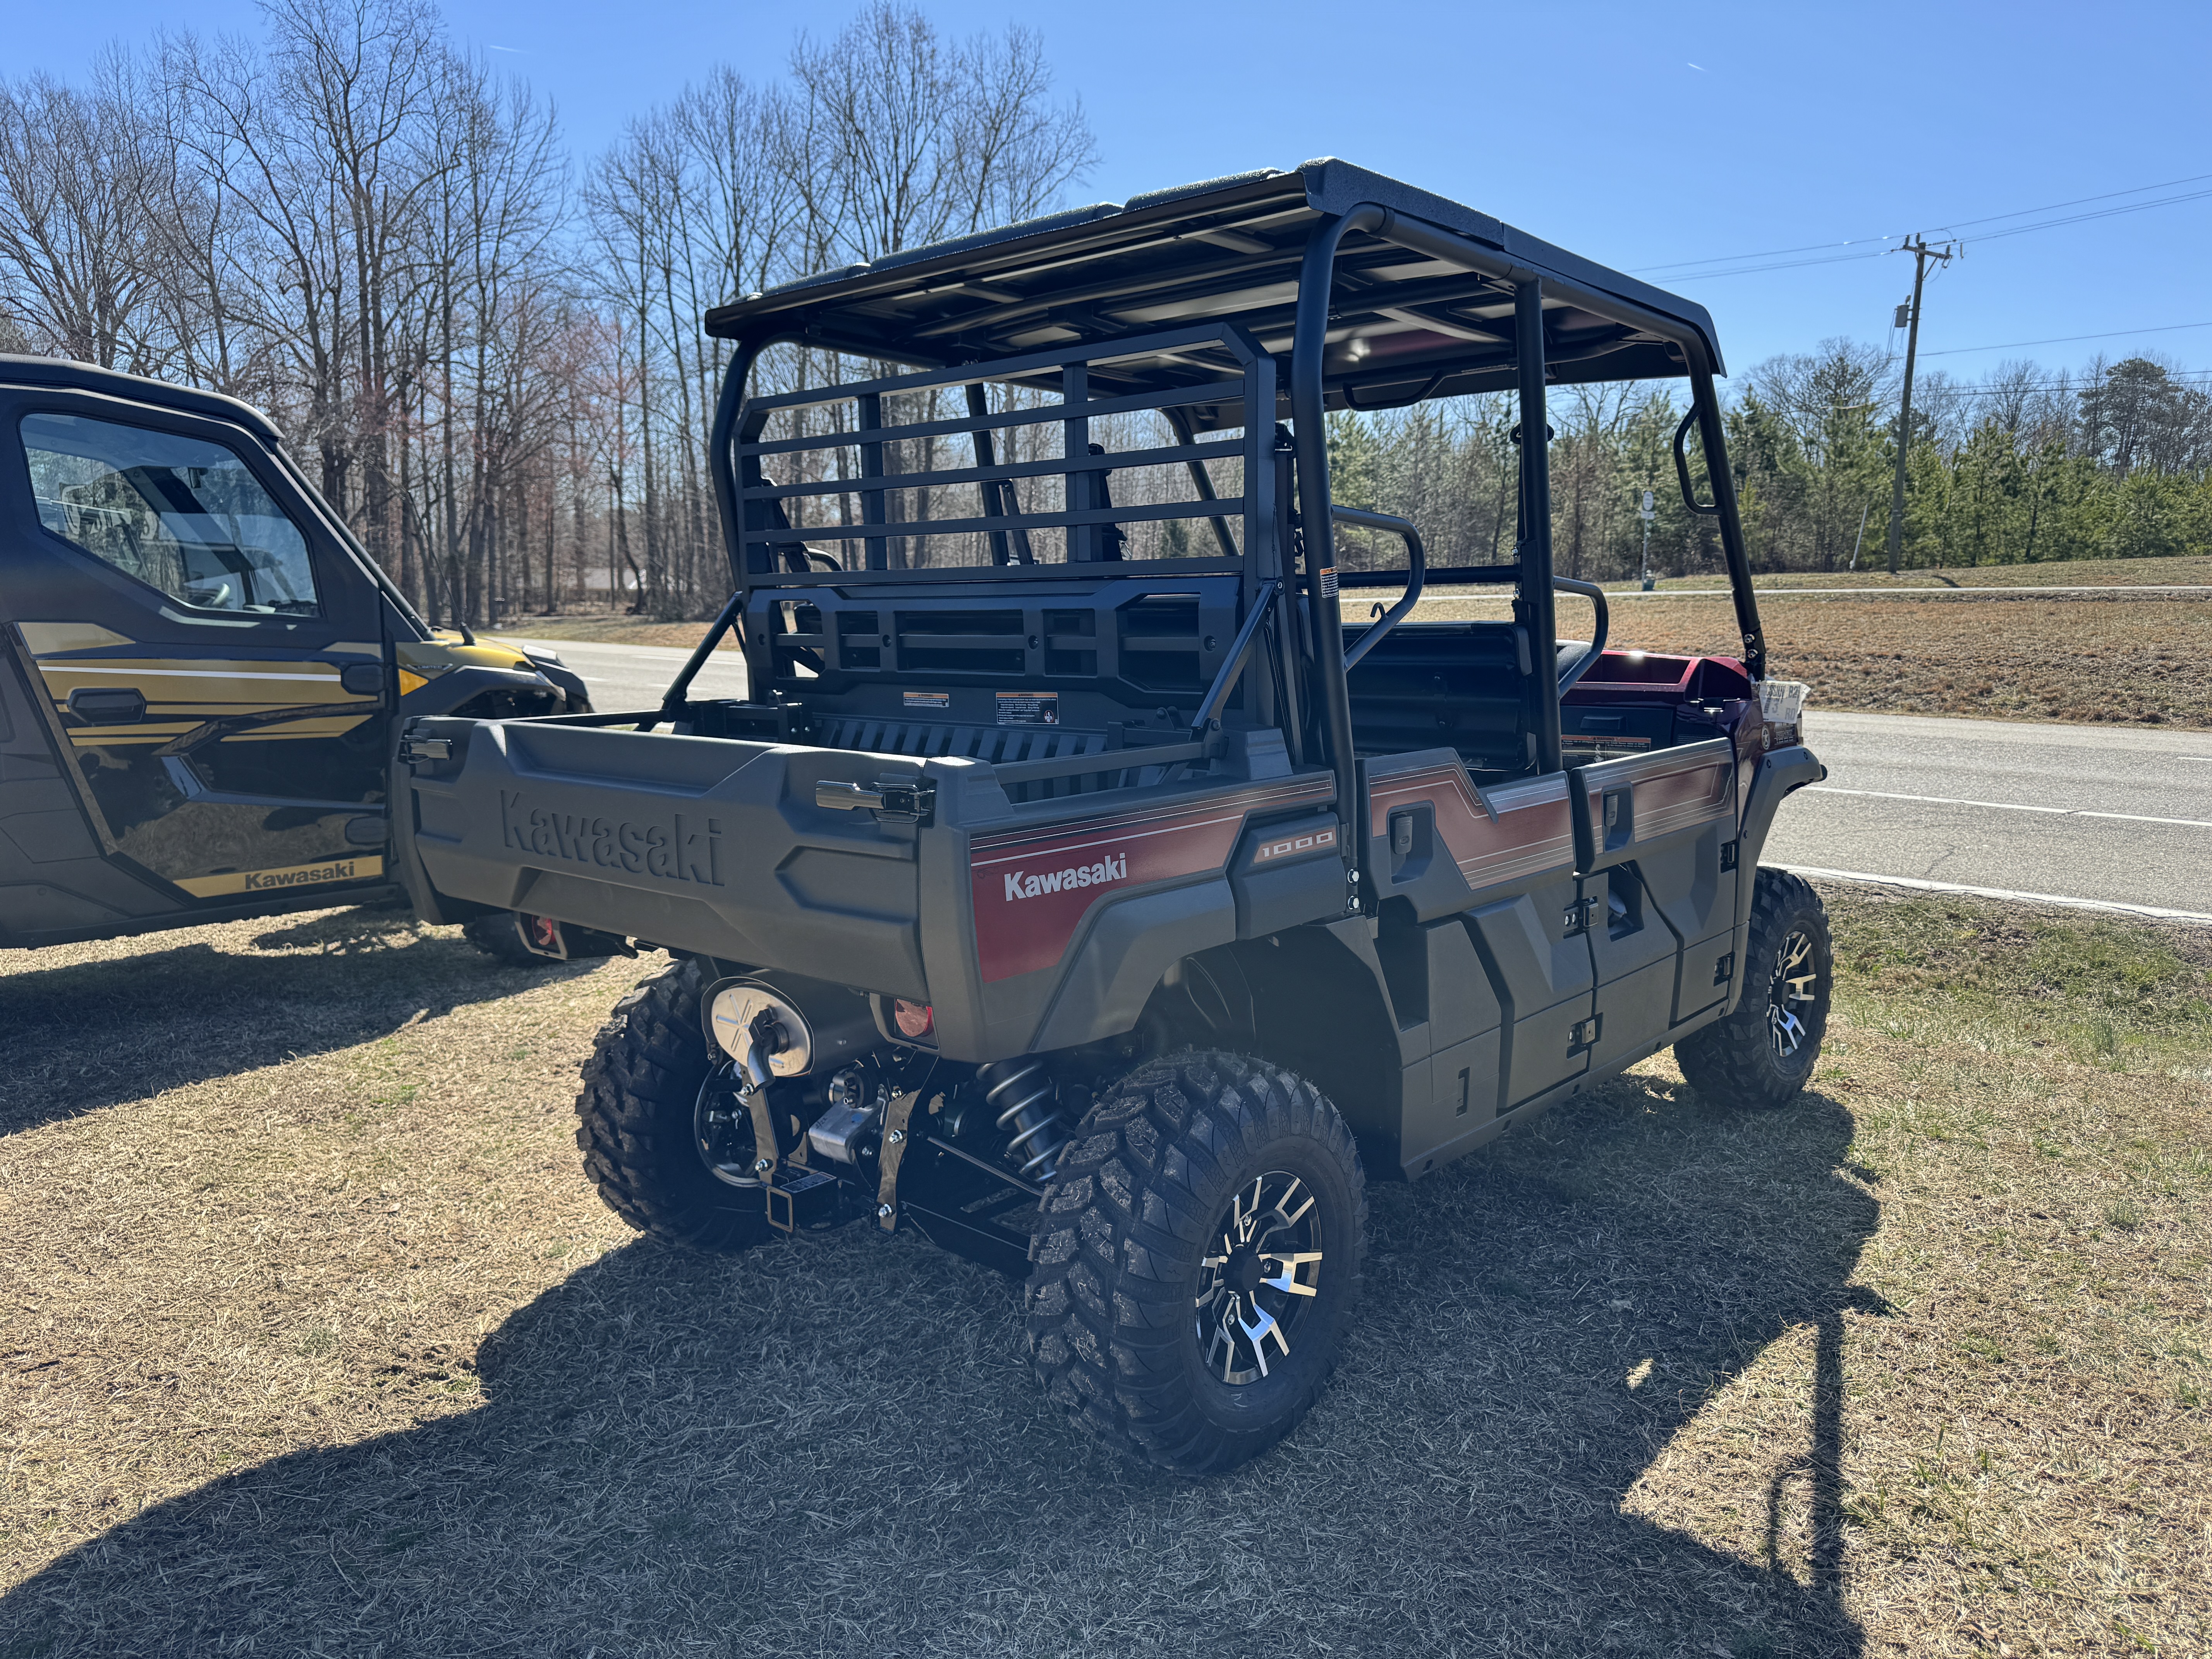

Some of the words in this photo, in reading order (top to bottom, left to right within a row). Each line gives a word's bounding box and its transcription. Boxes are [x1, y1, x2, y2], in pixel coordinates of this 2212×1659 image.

[500, 789, 725, 887] Kawasaki
[1262, 831, 1333, 858] 1000
[245, 861, 355, 890] Kawasaki
[1004, 852, 1127, 902] Kawasaki
